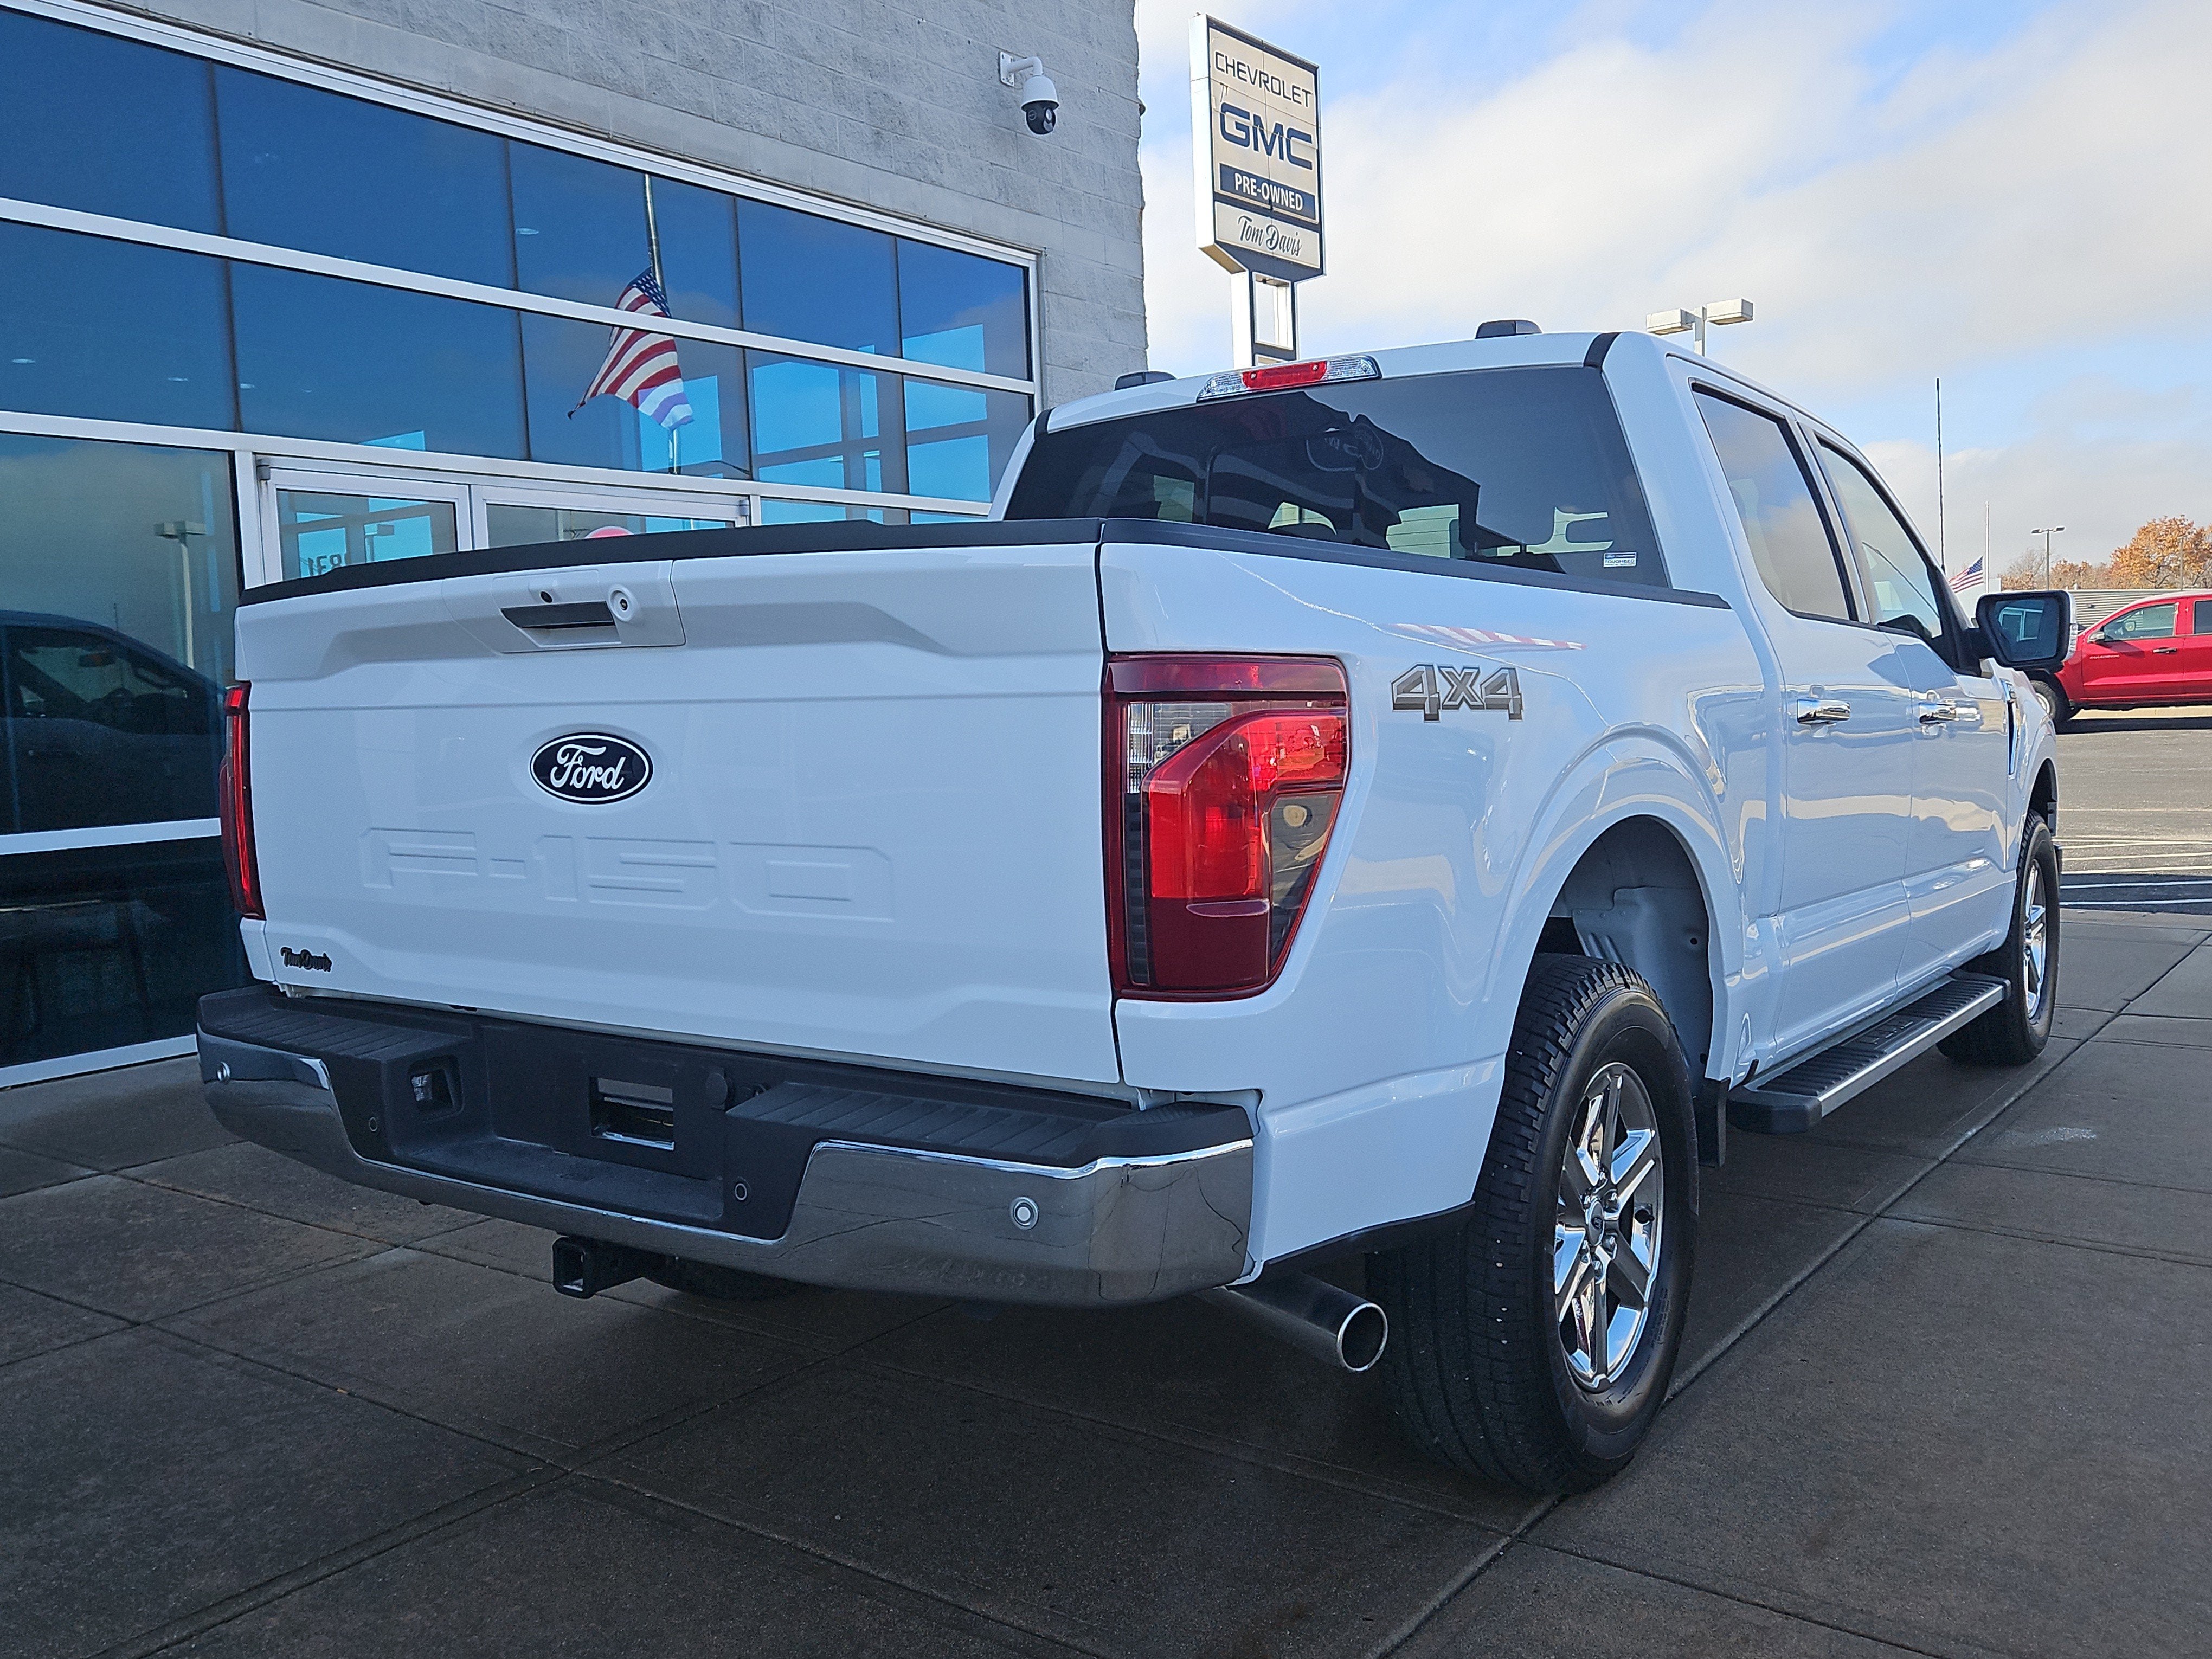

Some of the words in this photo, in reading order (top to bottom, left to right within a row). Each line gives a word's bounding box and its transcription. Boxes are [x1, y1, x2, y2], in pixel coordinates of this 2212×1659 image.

[1215, 51, 1311, 107] CHEVROLET
[1220, 102, 1313, 170] GMC
[1234, 172, 1303, 211] PRE-OWNED
[1238, 215, 1264, 246] Tom
[1266, 224, 1302, 256] Davis
[550, 744, 626, 789] Ford
[359, 827, 895, 924] F-150
